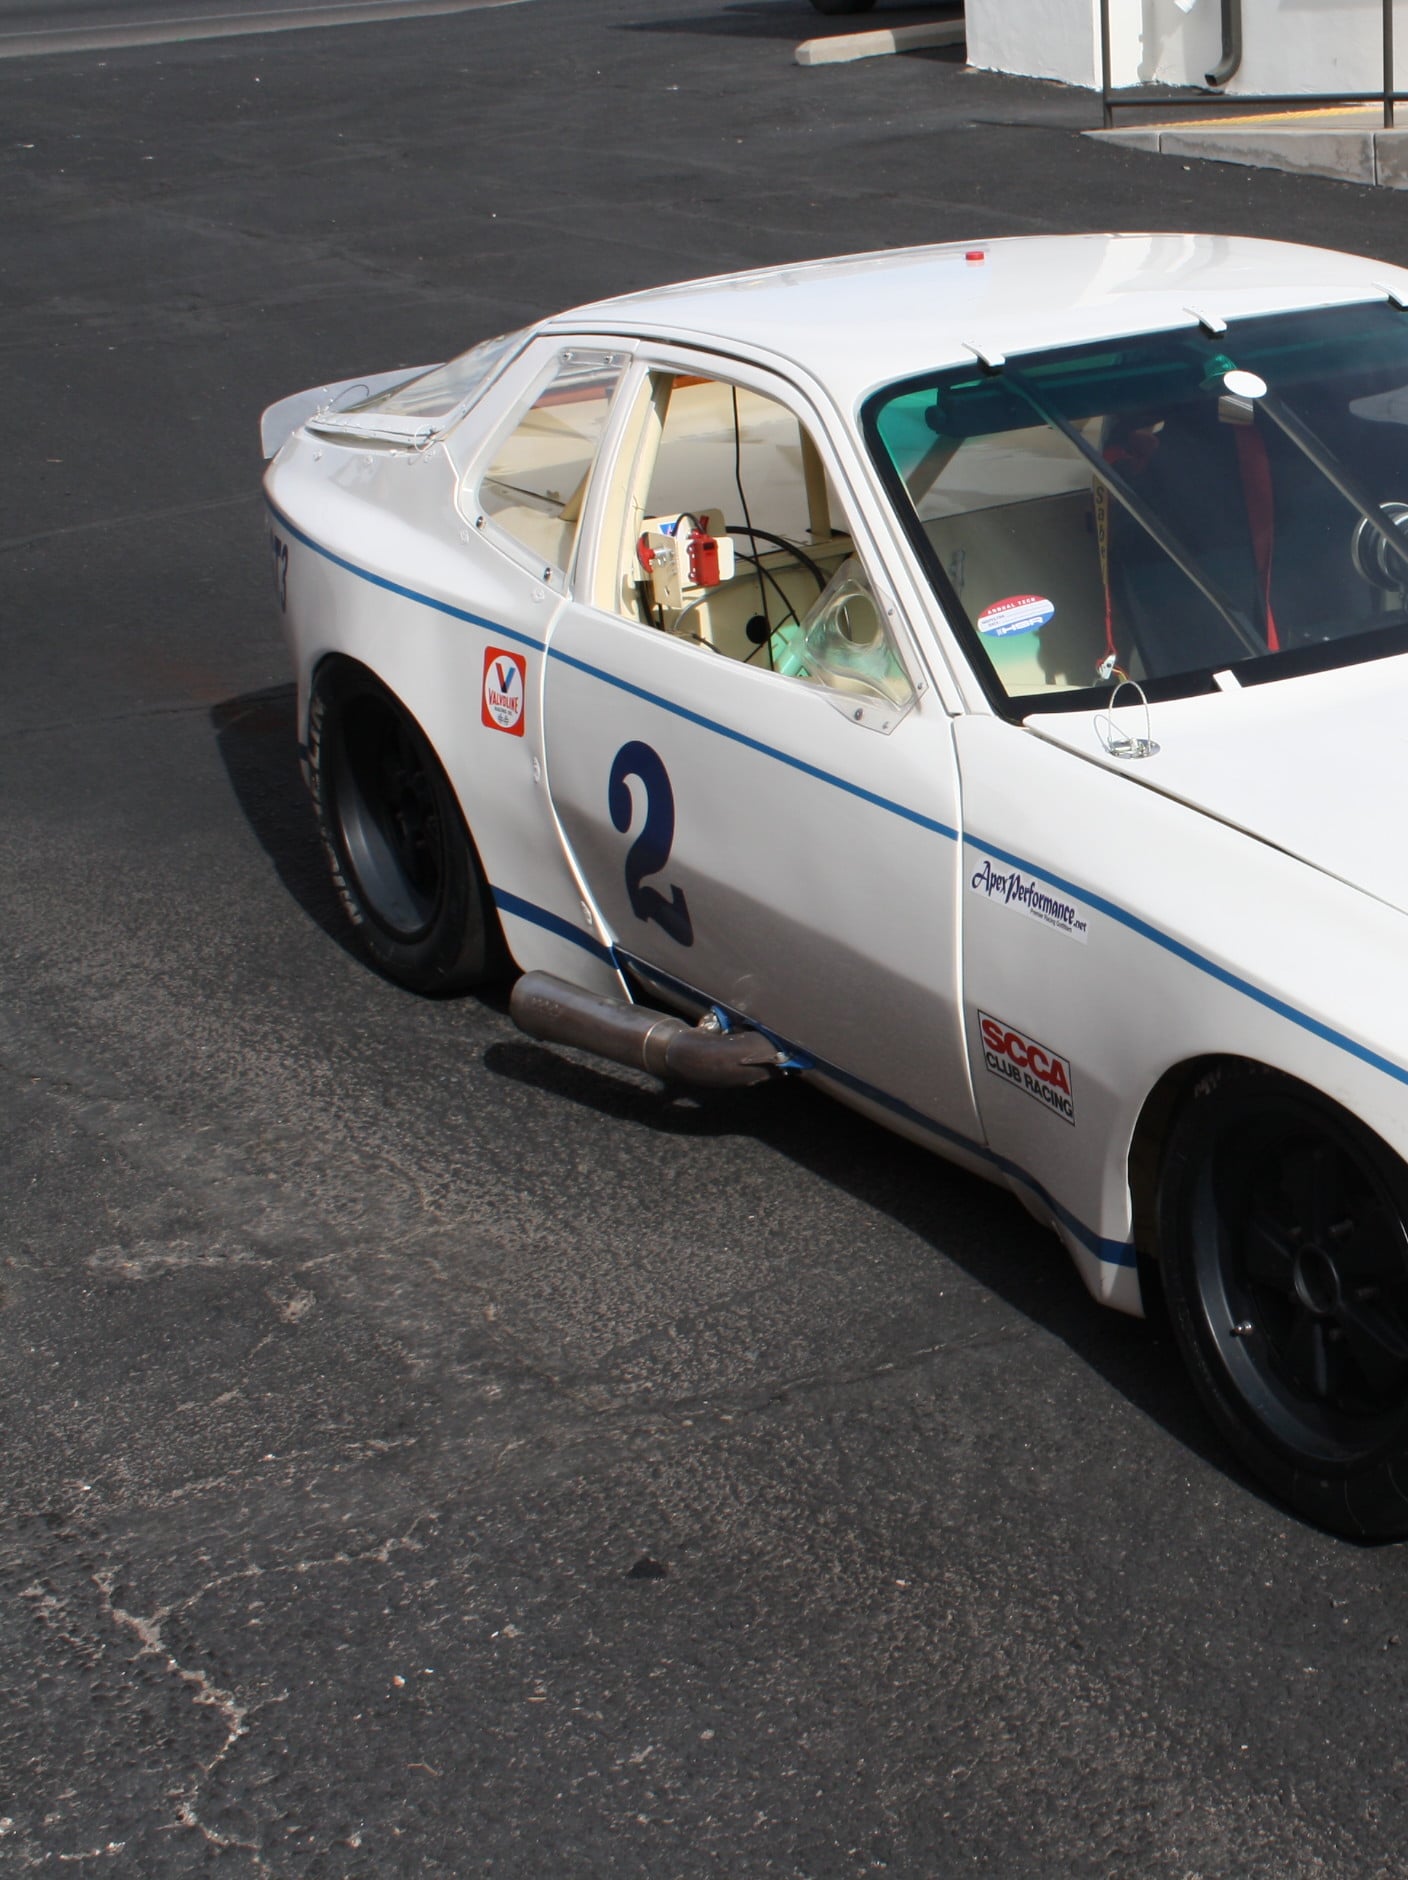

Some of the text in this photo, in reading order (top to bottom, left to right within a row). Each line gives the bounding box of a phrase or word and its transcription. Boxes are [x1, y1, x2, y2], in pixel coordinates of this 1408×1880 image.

[488, 687, 518, 714] VALVOLINE
[608, 740, 694, 947] 2
[981, 1019, 1071, 1096] SCCA
[985, 1051, 1073, 1117] CLUB RACING
